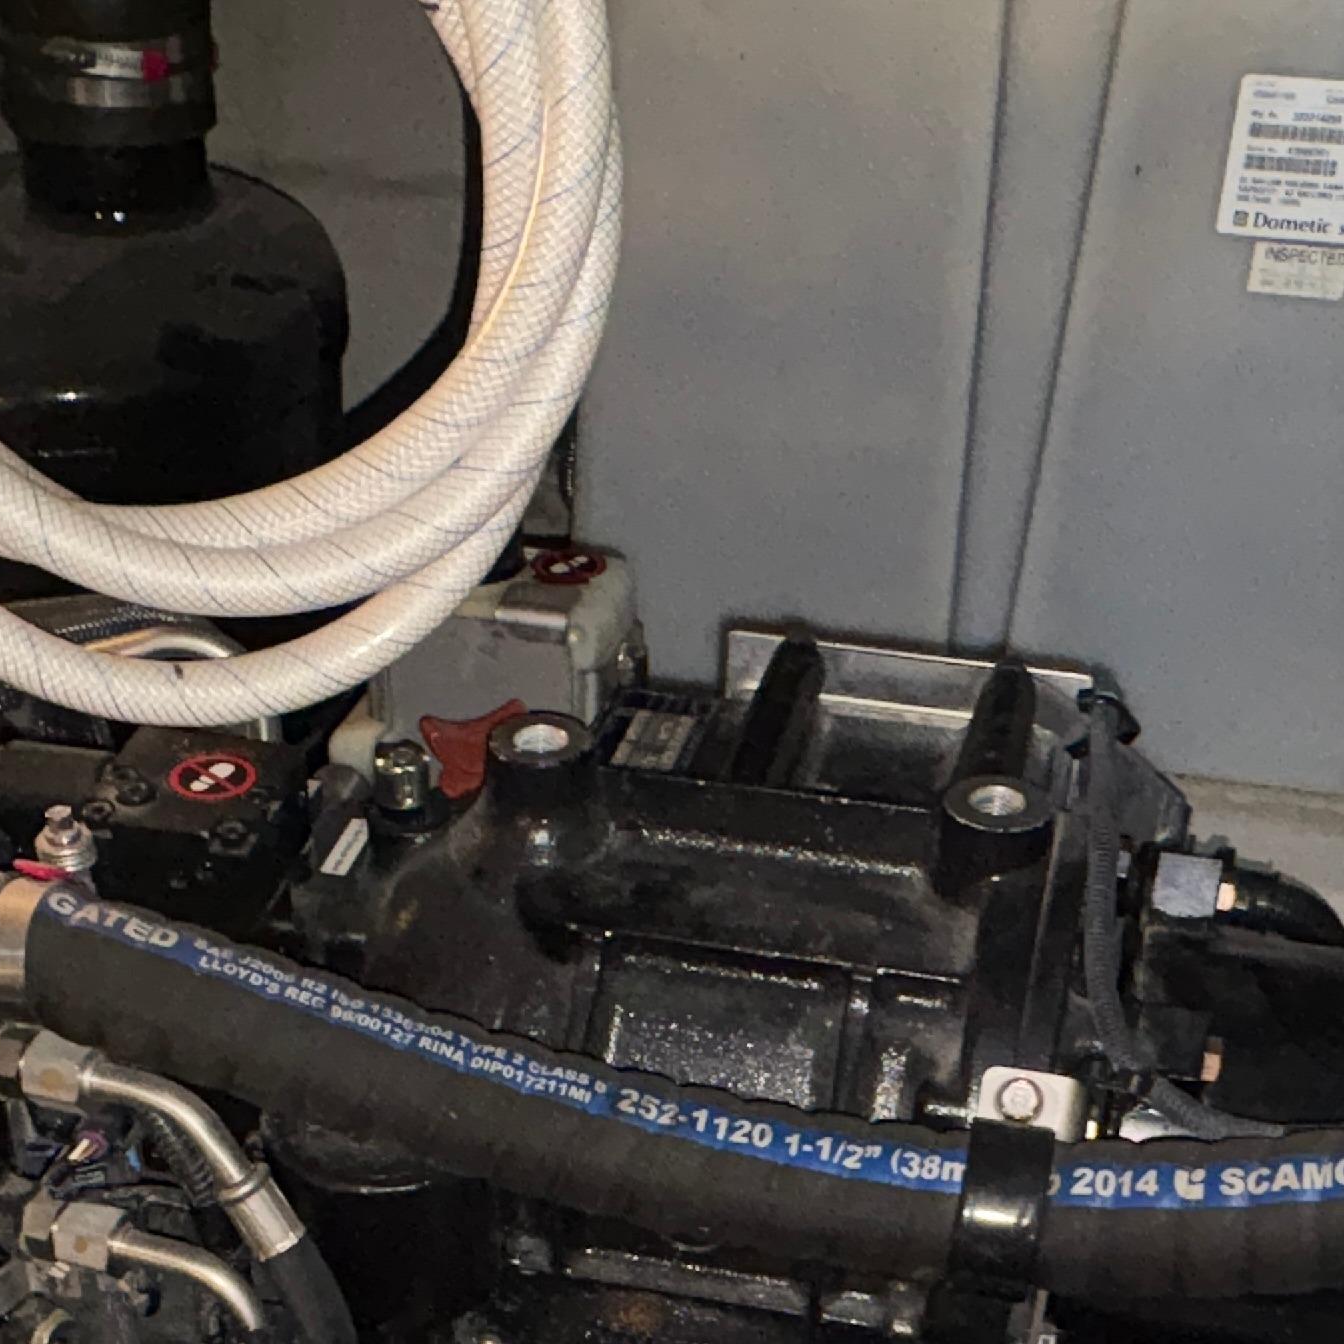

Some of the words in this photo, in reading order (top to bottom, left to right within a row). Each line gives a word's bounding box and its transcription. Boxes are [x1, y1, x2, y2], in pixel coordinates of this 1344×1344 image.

[1253, 211, 1330, 235] Dometic
[418, 1035, 465, 1066] RINA
[615, 1087, 774, 1149] 252-1120
[1069, 1166, 1160, 1198] 2014
